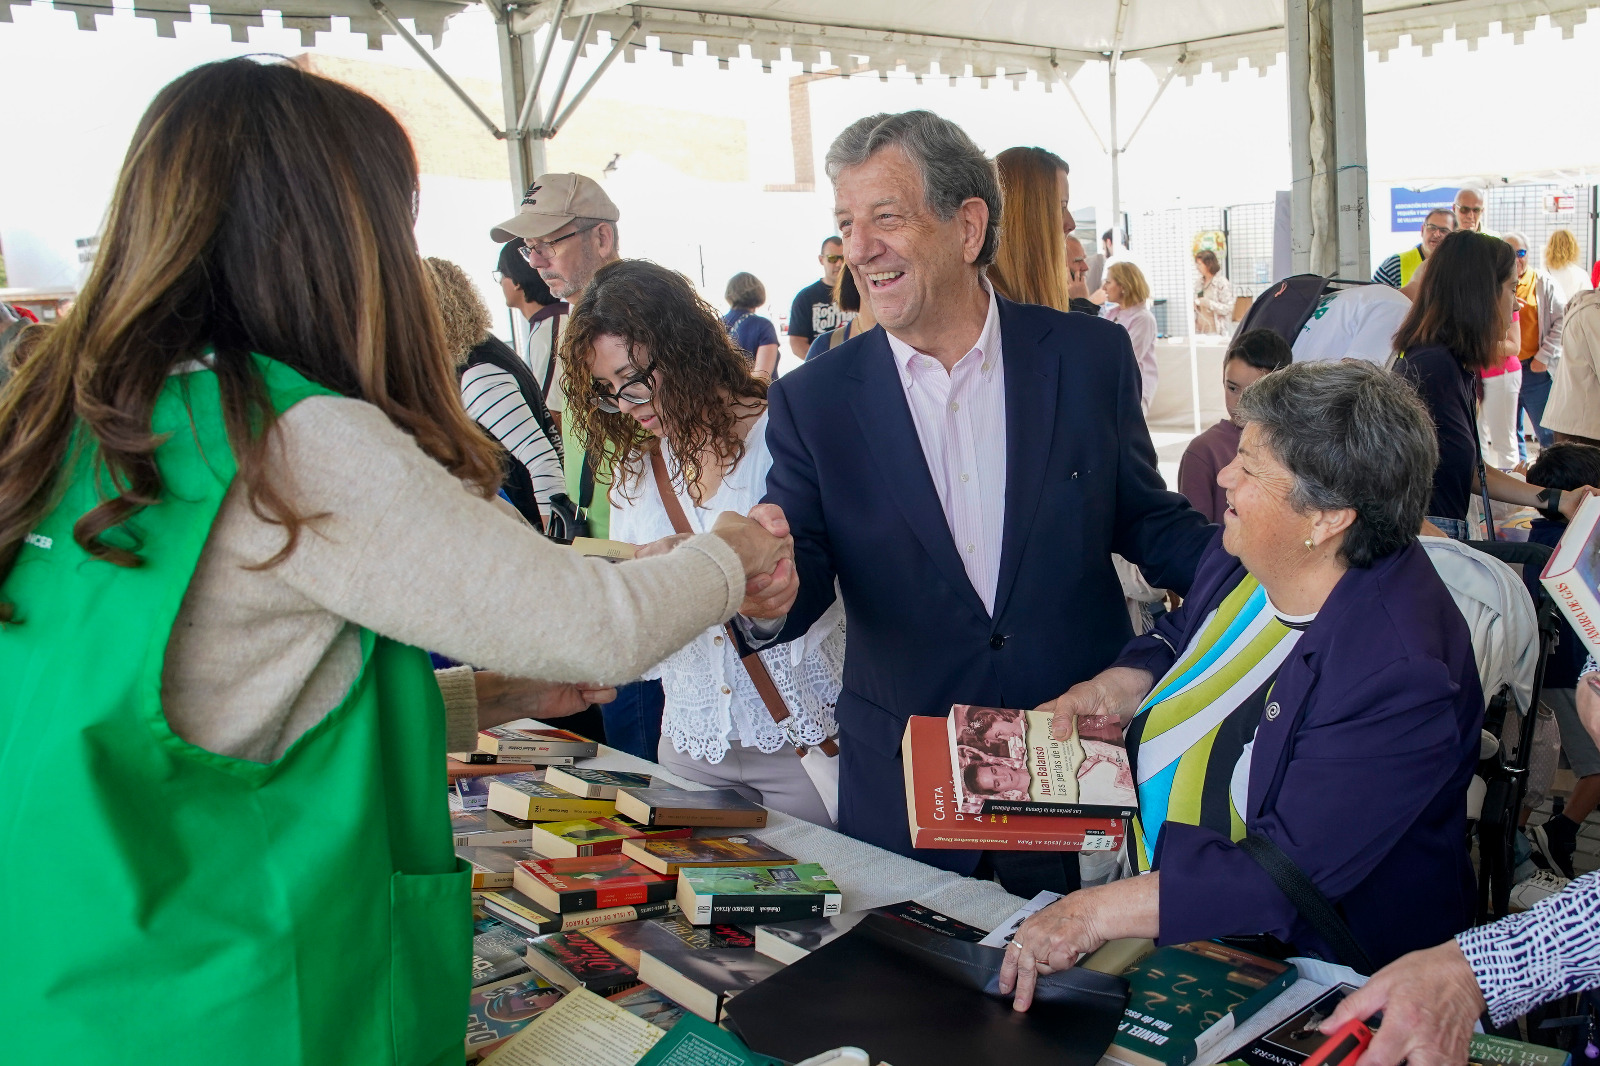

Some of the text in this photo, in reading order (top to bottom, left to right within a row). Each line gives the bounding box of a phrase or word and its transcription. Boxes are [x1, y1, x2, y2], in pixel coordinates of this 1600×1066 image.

[1556, 582, 1572, 598] GAS
[1053, 748, 1061, 760] de
[1034, 745, 1052, 796] Juan Balansó
[1055, 762, 1066, 782] perlas
[1057, 783, 1068, 797] Las
[933, 786, 946, 821] CARTA
[565, 920, 584, 928] FAROS
[585, 917, 590, 926] 5
[1124, 1008, 1173, 1031] Mal de esc
[1127, 1024, 1169, 1046] DANIEL
[1252, 1047, 1297, 1066] SANGRE
[1520, 1052, 1549, 1063] DEL
